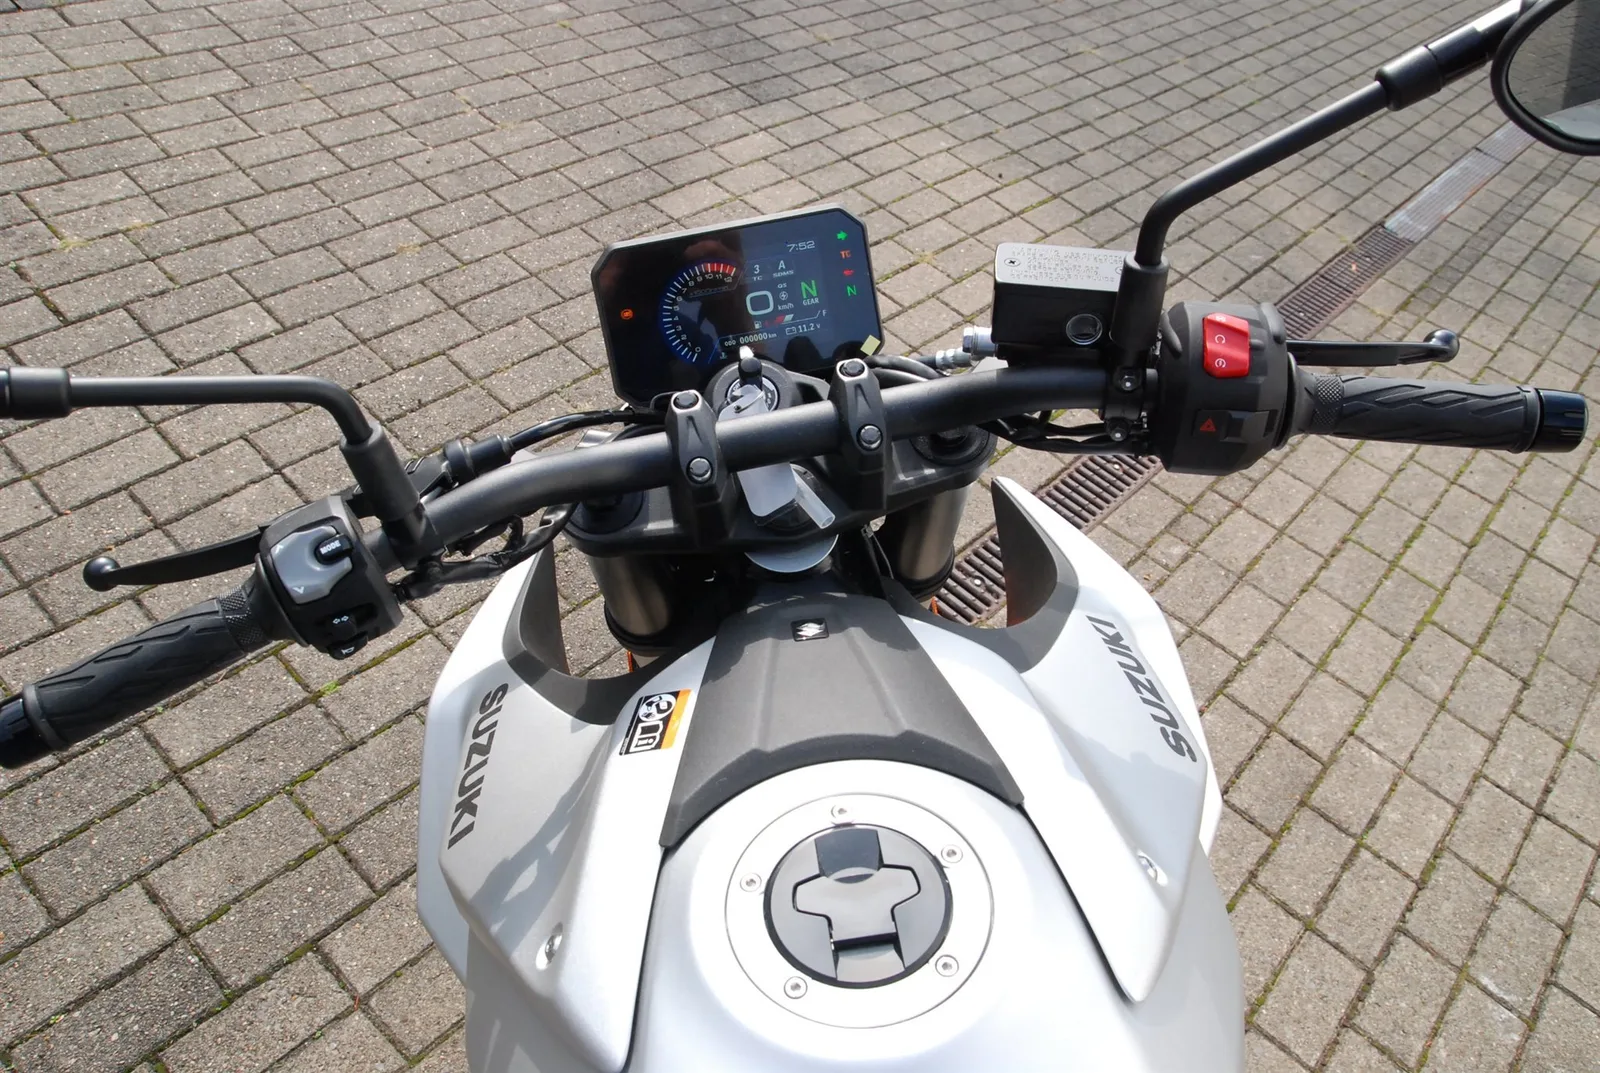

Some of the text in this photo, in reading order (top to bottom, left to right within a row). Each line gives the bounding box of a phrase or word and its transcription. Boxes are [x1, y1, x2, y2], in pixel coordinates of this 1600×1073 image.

[787, 240, 815, 252] 7:52
[840, 250, 851, 259] TC
[753, 264, 760, 274] 3
[778, 260, 786, 270] A
[801, 280, 818, 298] N
[847, 285, 857, 296] N
[745, 290, 774, 315] 0
[802, 298, 819, 306] GEAR
[798, 323, 814, 333] 11.2
[739, 332, 768, 344] 000000
[320, 540, 341, 554] MODE
[1086, 615, 1197, 763] SUZUKI
[447, 682, 509, 850] SUZUKI
